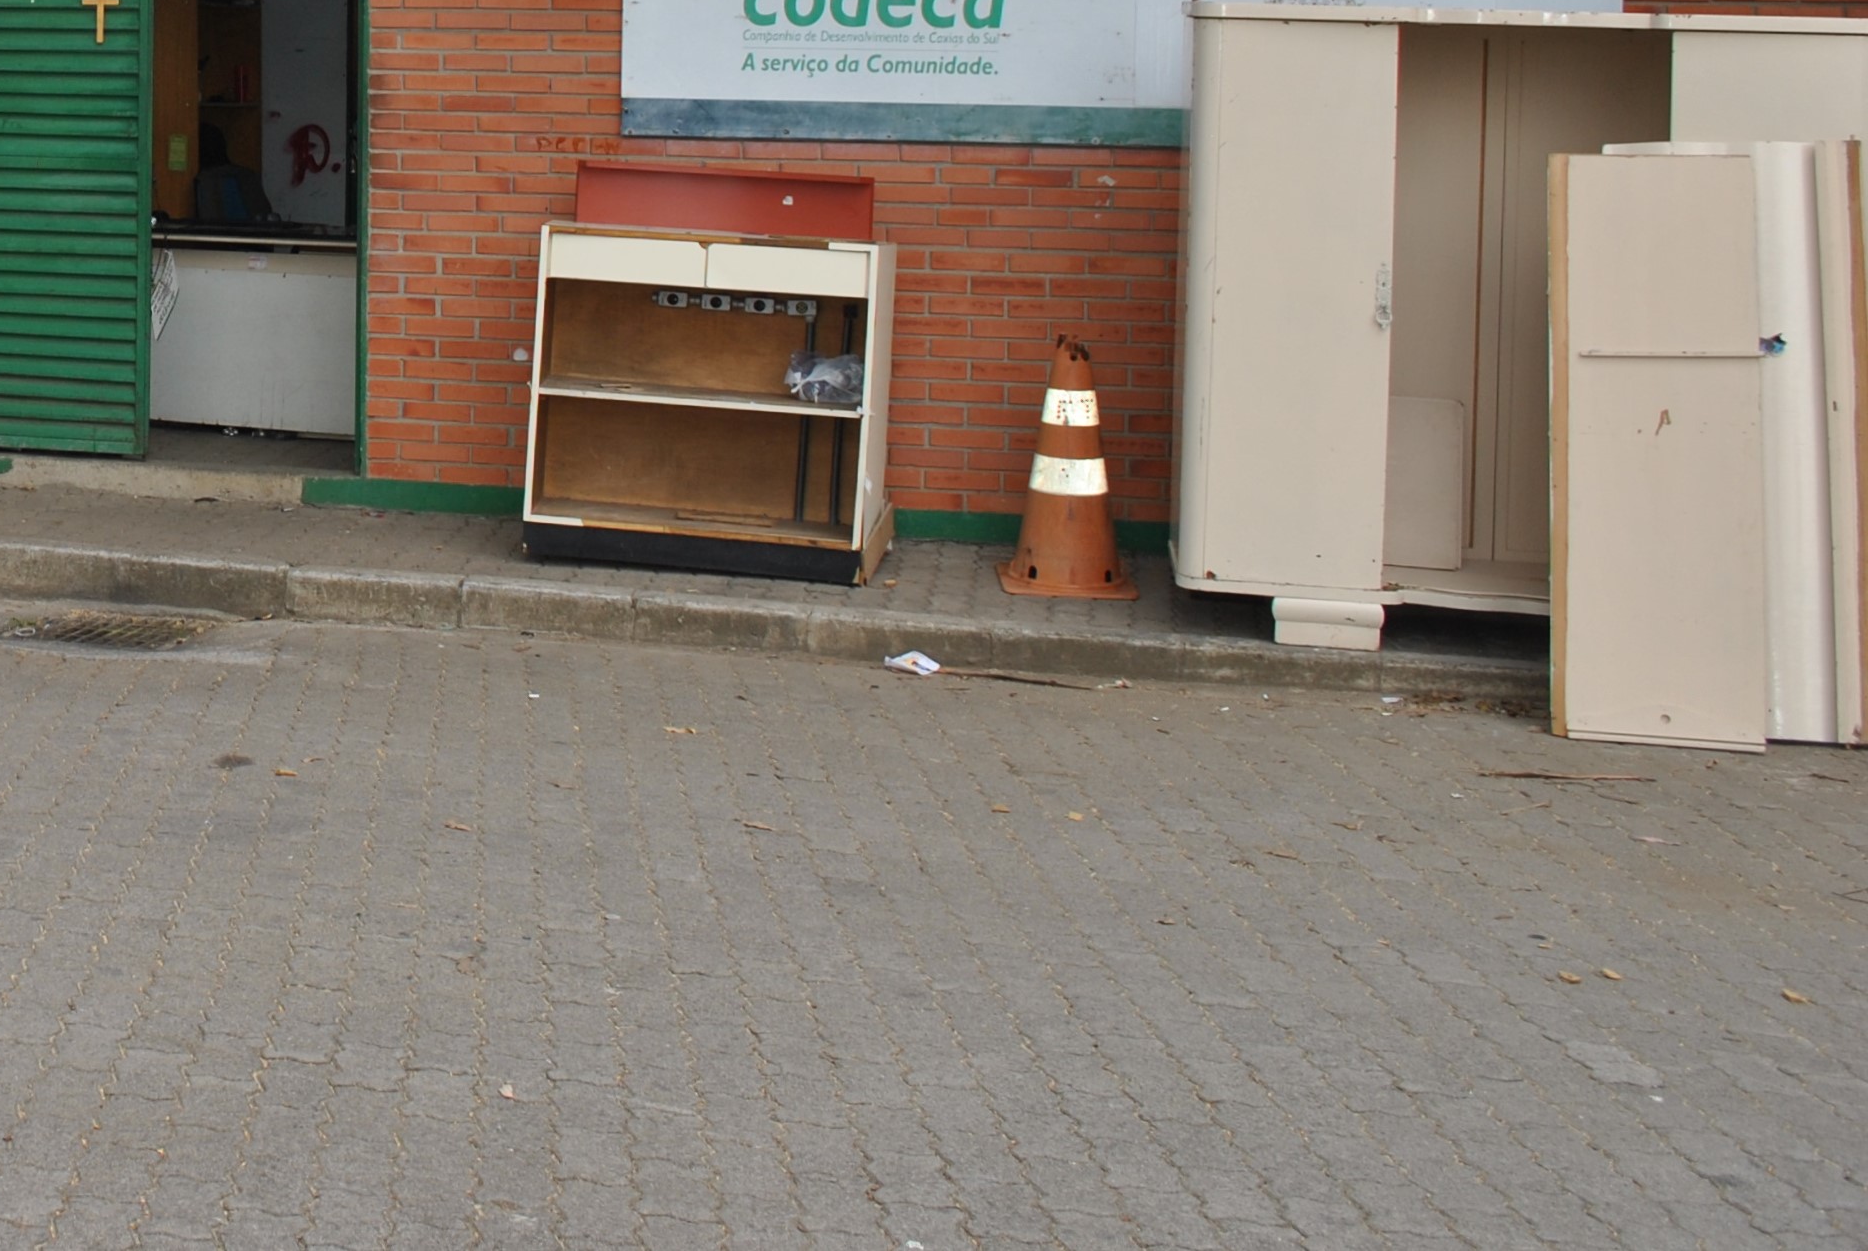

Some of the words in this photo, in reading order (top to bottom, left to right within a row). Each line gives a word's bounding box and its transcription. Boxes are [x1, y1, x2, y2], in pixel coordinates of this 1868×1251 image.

[743, 29, 801, 43] Companhia
[805, 30, 817, 42] de
[820, 30, 910, 43] Desenvolvimento
[912, 31, 925, 43] de
[929, 32, 964, 46] Caxias
[966, 32, 980, 44] do
[741, 52, 756, 71] A
[761, 55, 829, 78] serviço
[835, 54, 859, 72] da
[866, 54, 999, 75] Comunidade.
